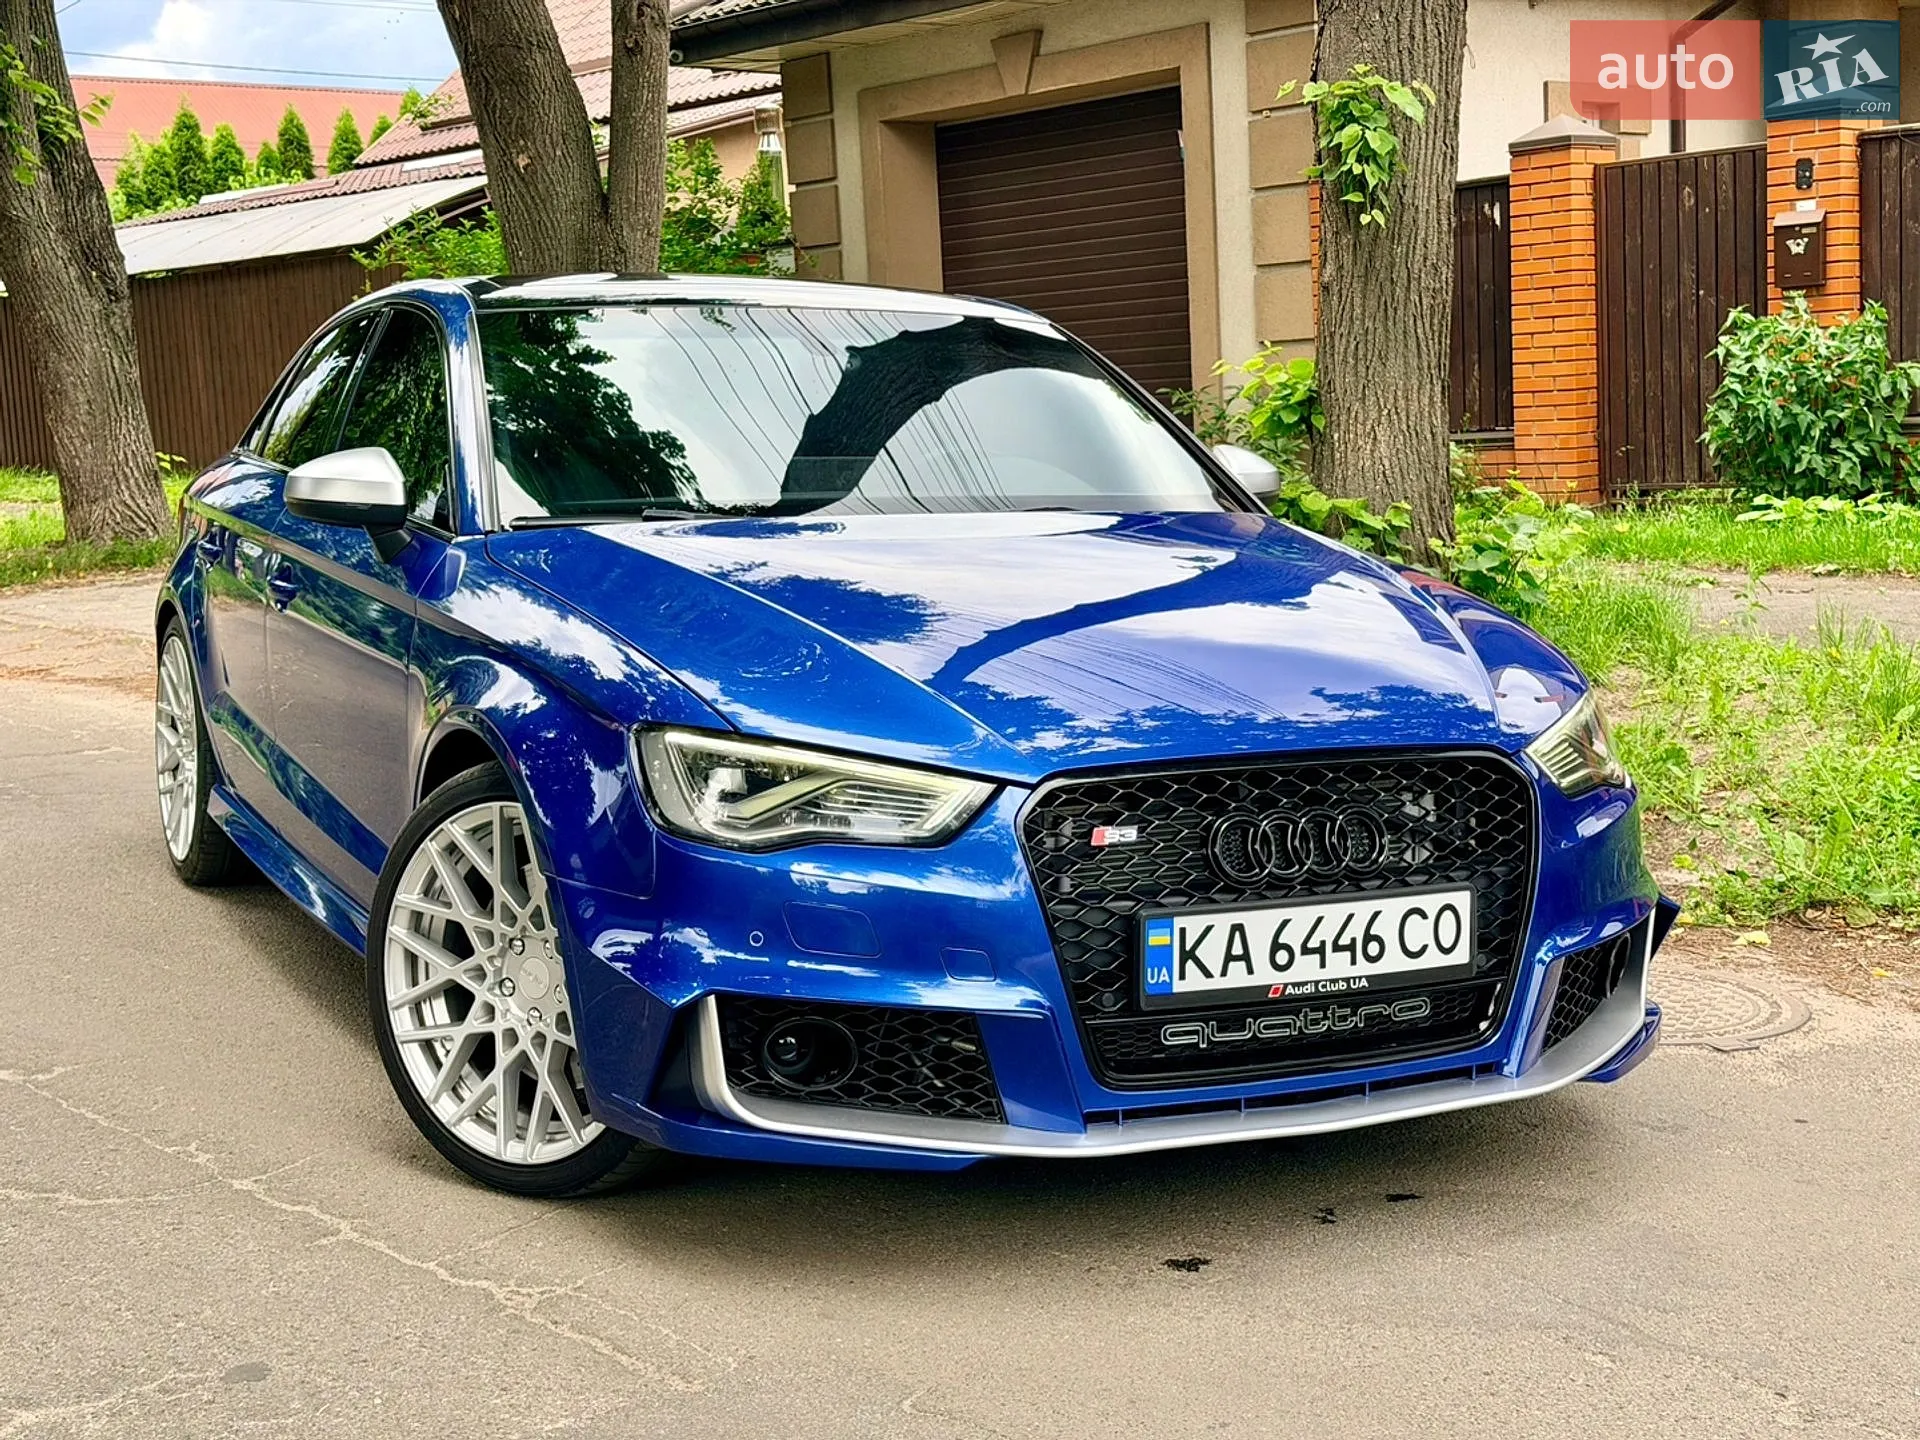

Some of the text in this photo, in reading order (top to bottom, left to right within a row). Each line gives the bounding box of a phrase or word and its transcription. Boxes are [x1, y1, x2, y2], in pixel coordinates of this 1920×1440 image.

[1178, 902, 1462, 981] KA 6446 CO
[1147, 967, 1170, 984] UA
[1285, 977, 1369, 996] Audi Club UA
[1161, 997, 1431, 1048] quattro
